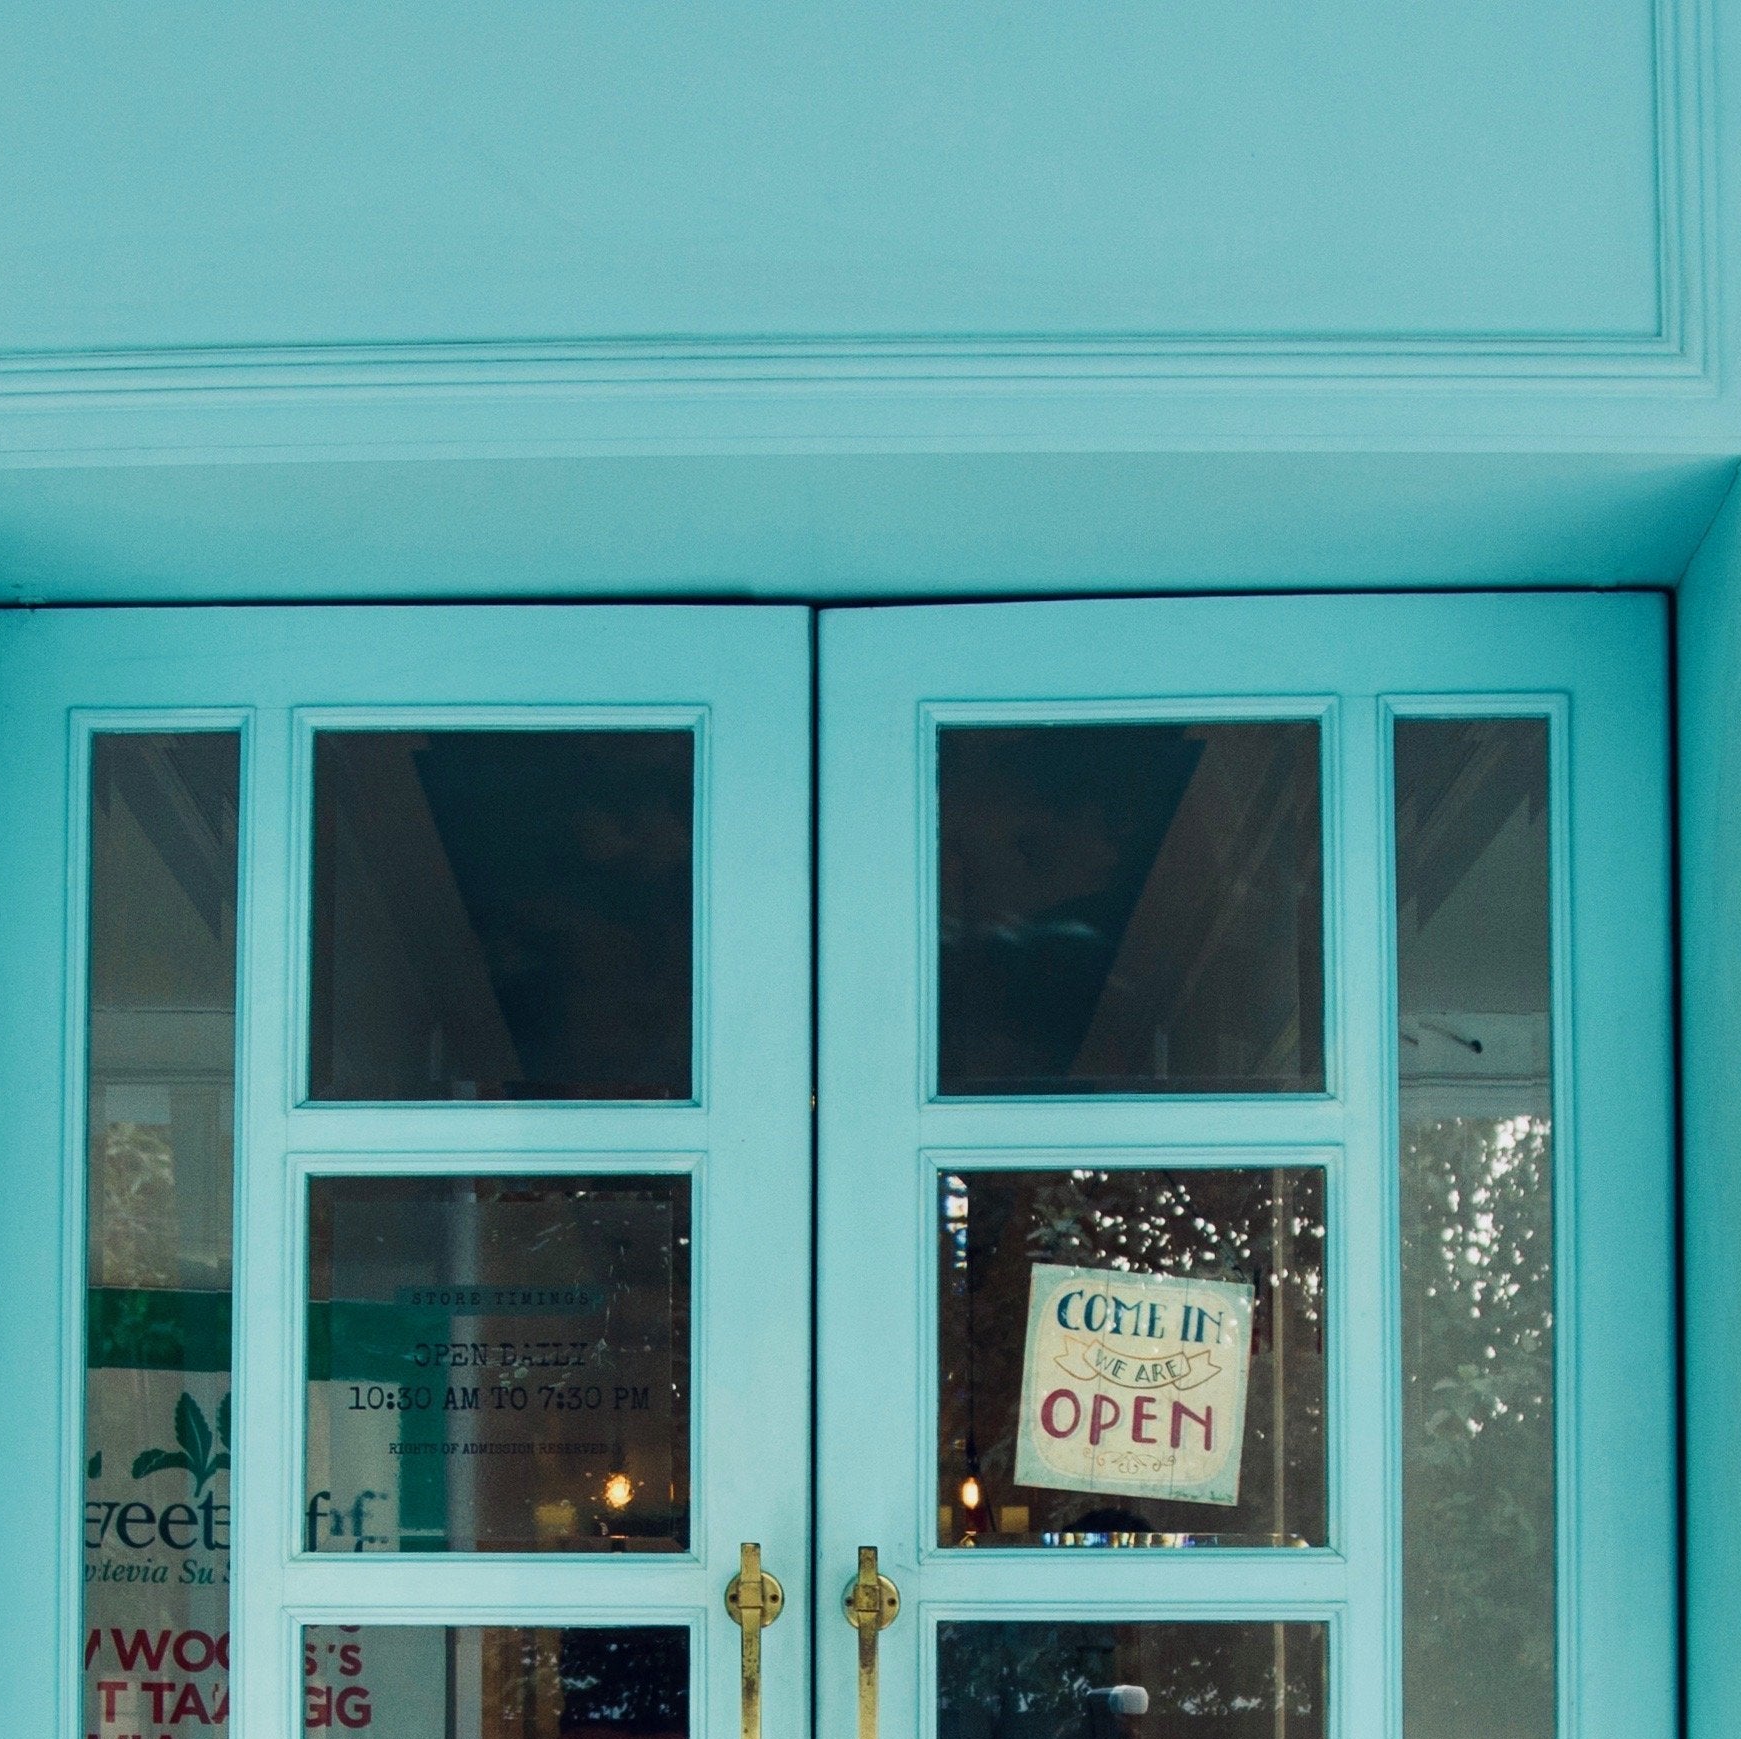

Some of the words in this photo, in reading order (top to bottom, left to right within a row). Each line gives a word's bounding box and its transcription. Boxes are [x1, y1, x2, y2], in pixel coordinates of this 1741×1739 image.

[411, 1291, 481, 1306] STORE
[494, 1290, 590, 1306] TIMINGS
[1056, 1289, 1165, 1341] COME
[1180, 1304, 1224, 1345] IN
[414, 1342, 489, 1368] OPEN
[500, 1342, 588, 1368] DAILY
[1096, 1347, 1127, 1379] WE
[1134, 1356, 1183, 1384] ARE
[348, 1386, 431, 1411] 10:30
[442, 1386, 480, 1411] AM
[491, 1386, 528, 1411] TO
[537, 1386, 603, 1411] 7:30
[613, 1386, 650, 1411] PM
[1040, 1388, 1213, 1452] OPEN
[389, 1443, 438, 1455] RIGHTS
[442, 1443, 459, 1455] OF
[462, 1443, 532, 1455] ADMISSION
[538, 1443, 609, 1455] RESERVED
